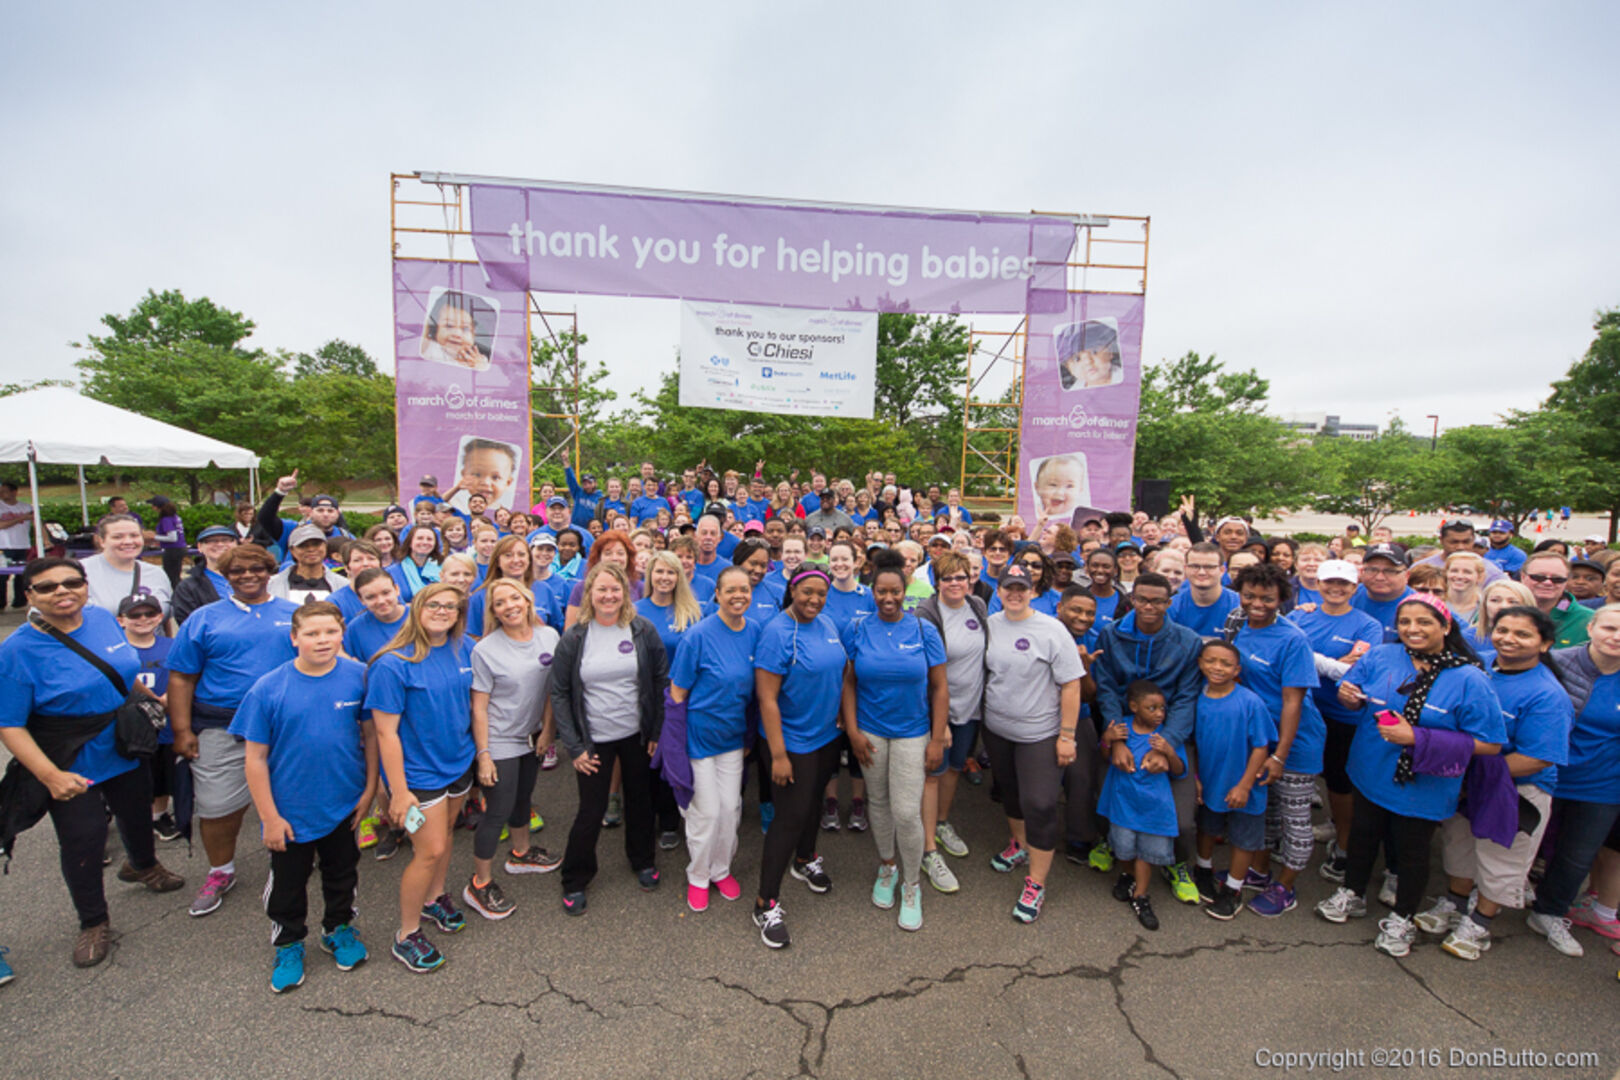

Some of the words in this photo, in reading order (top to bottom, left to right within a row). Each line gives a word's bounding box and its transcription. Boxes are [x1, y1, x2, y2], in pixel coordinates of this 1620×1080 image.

[508, 219, 620, 260] thank
[631, 235, 701, 269] you
[713, 233, 766, 270] for
[776, 237, 909, 286] helping
[920, 245, 1038, 281] babies
[715, 326, 744, 338] thank
[746, 330, 765, 341] you
[767, 330, 777, 340] to
[779, 332, 796, 341] our
[798, 333, 845, 344] sponsors!
[763, 342, 815, 360] Chiesi
[819, 370, 857, 381] MetLife
[407, 394, 445, 406] march
[465, 395, 479, 407] of
[479, 396, 519, 409] dimes
[1032, 414, 1068, 425] march
[1086, 416, 1098, 426] of
